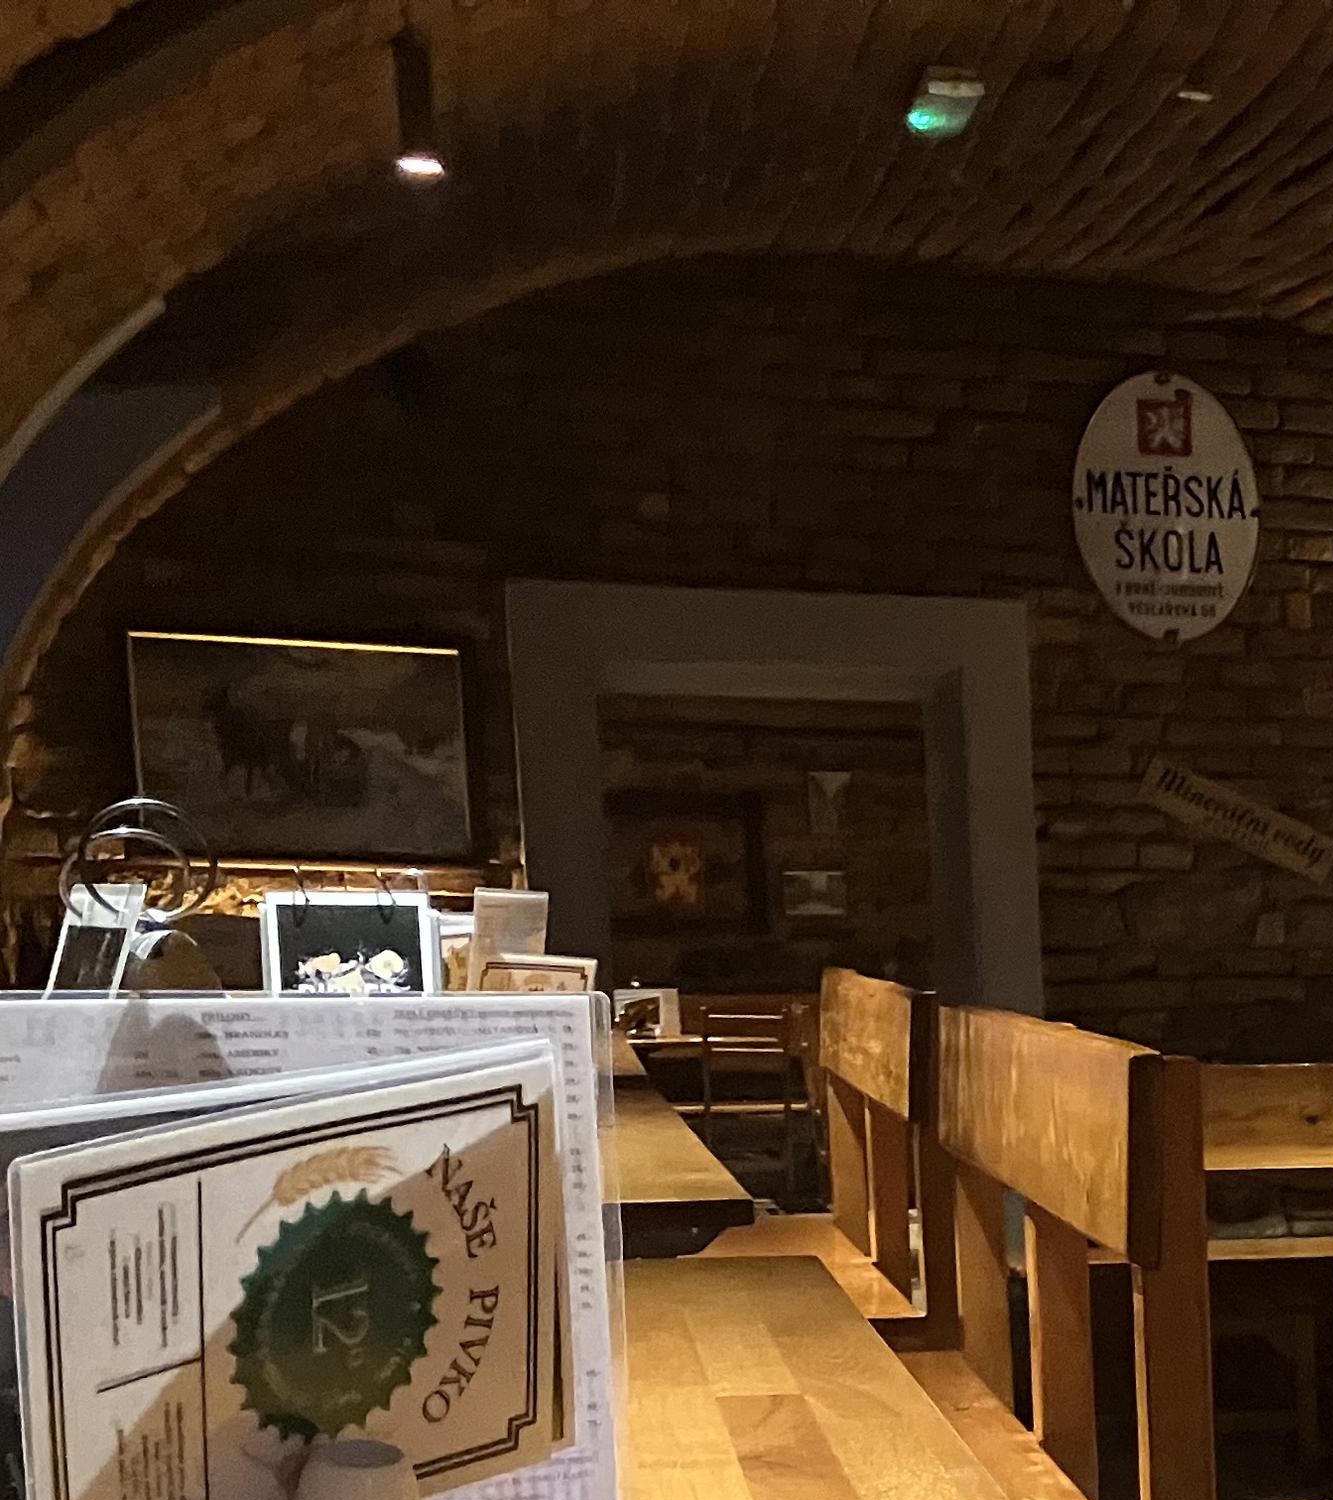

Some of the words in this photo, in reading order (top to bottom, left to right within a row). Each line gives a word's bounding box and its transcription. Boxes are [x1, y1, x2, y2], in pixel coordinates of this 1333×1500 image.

[1087, 465, 1246, 520] MATEŘSKÁ
[1115, 521, 1224, 575] ŠKOLA
[425, 1143, 498, 1259] NAŠE
[421, 1285, 500, 1424] PIVKO
